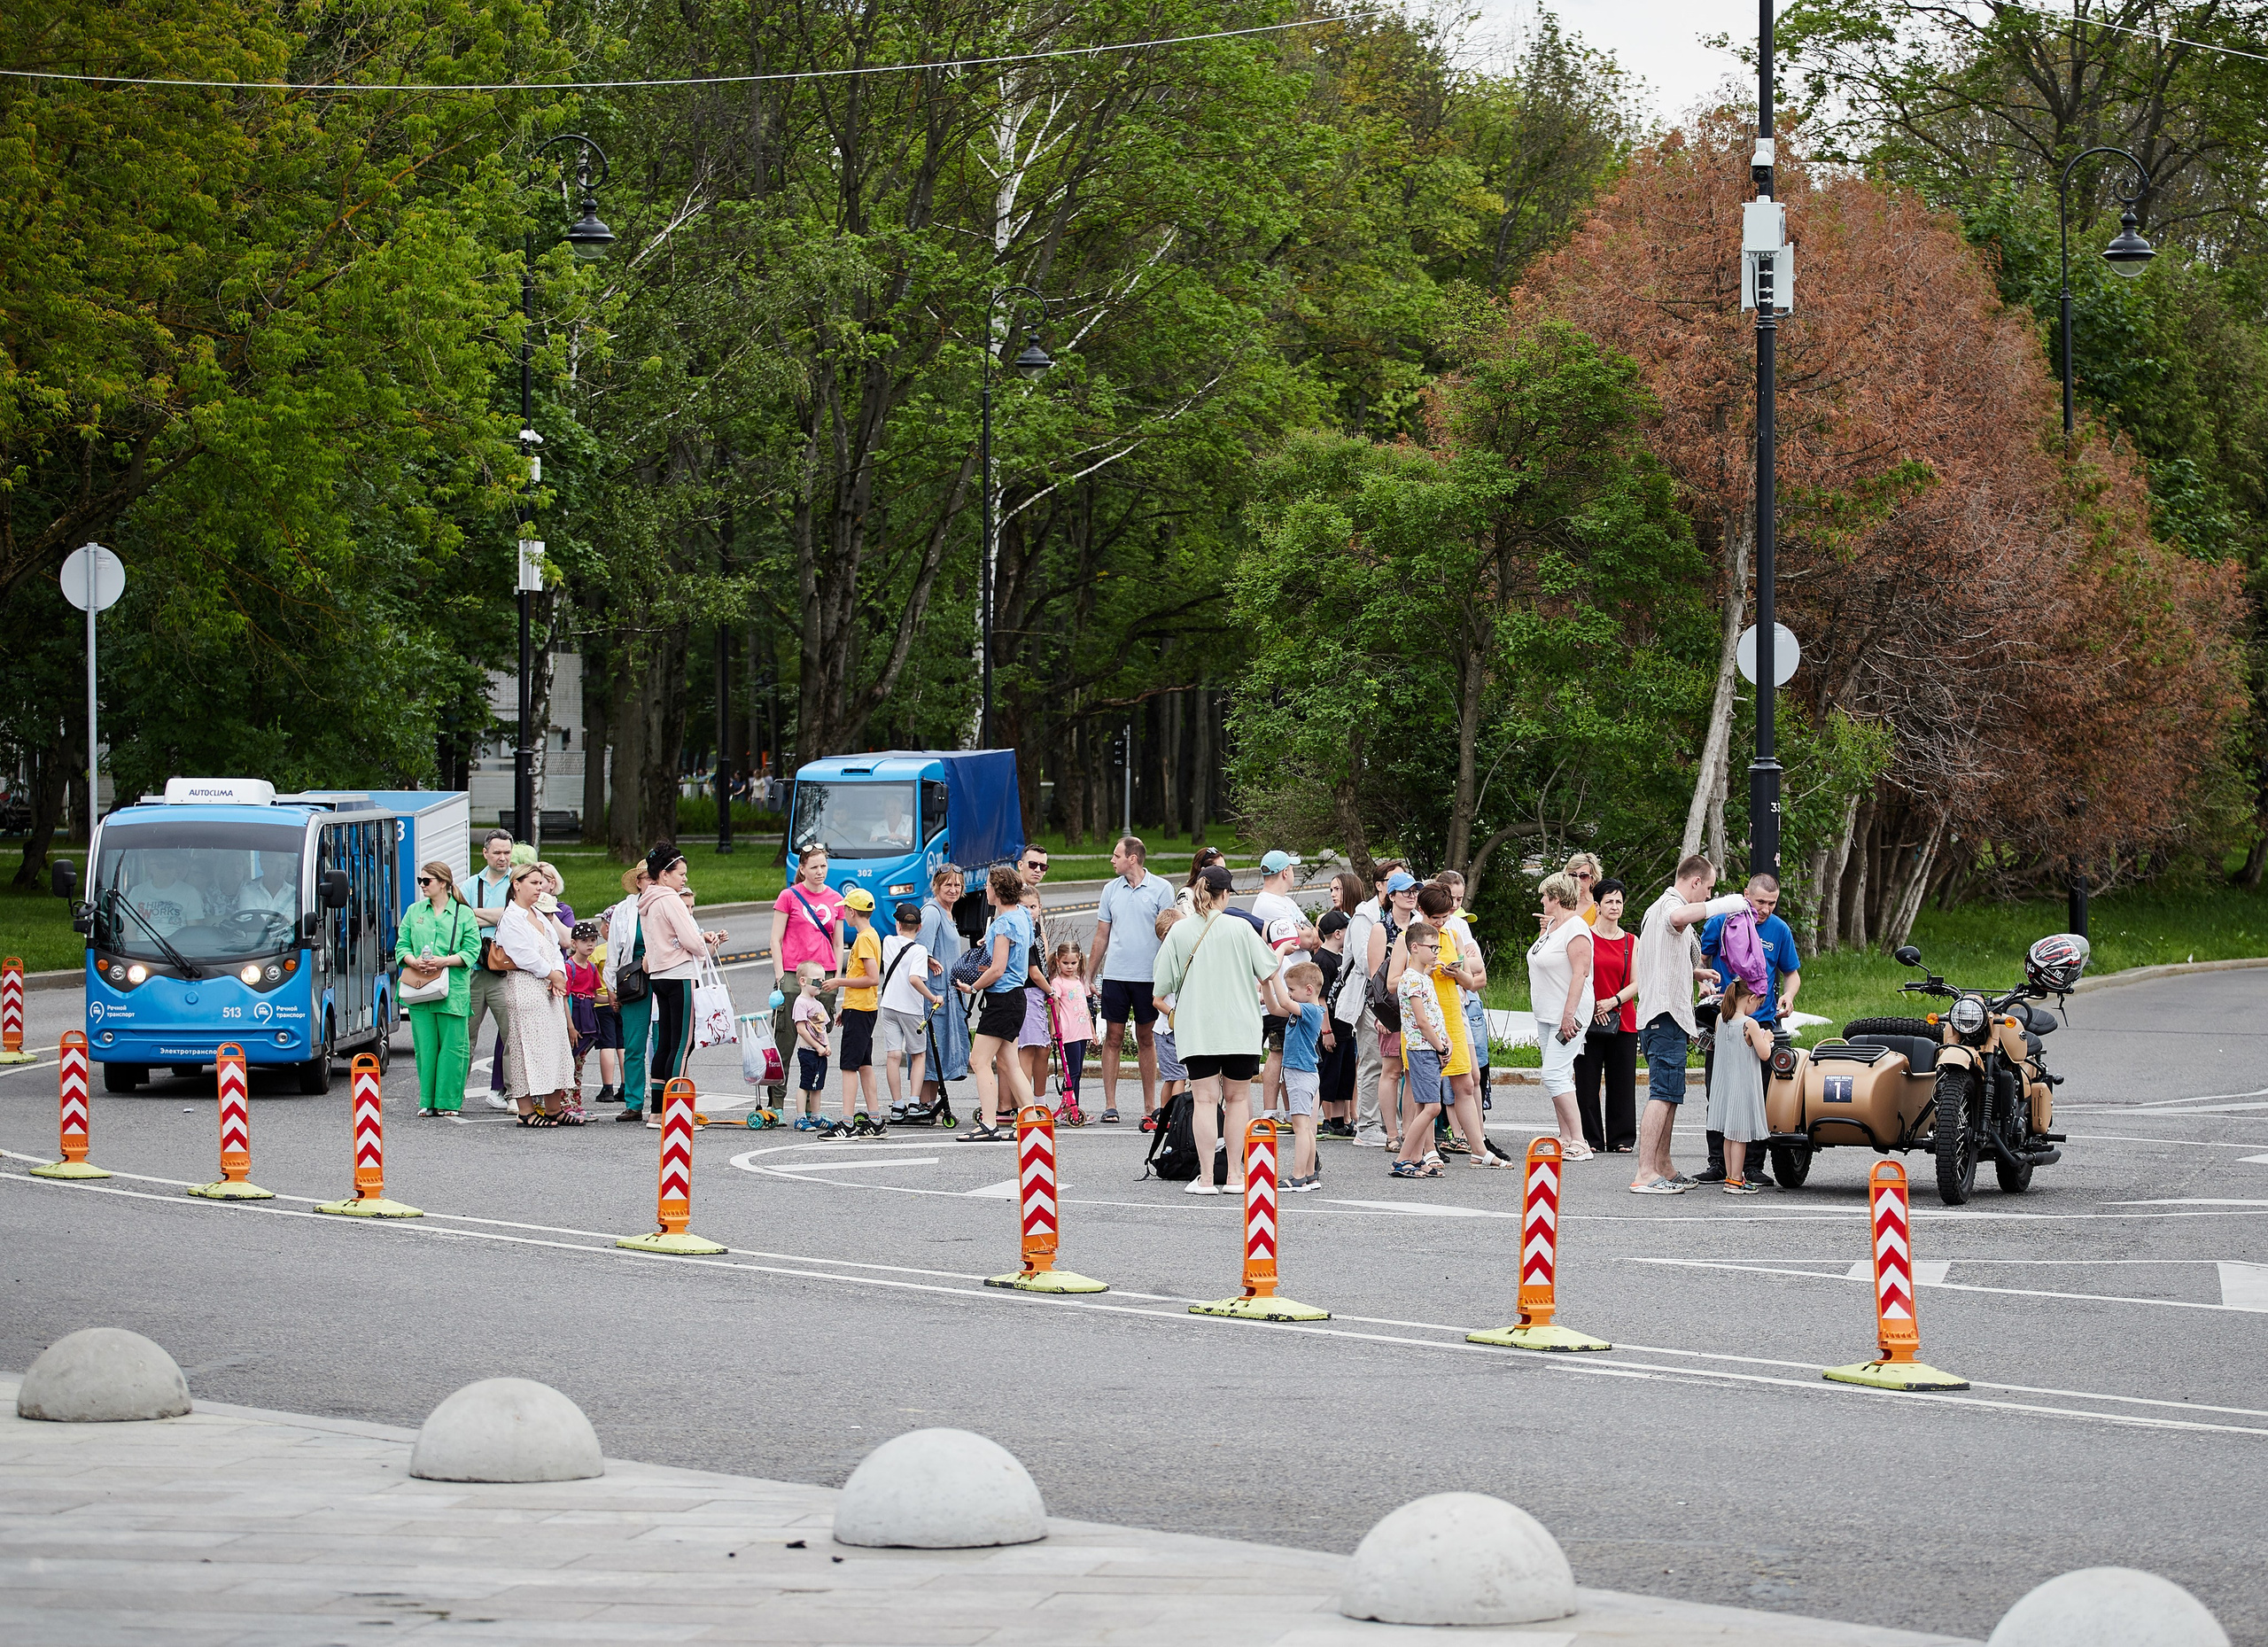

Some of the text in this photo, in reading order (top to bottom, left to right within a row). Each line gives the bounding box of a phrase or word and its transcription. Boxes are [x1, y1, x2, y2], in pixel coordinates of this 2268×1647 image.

[222, 1006, 242, 1018] 513
[159, 1047, 226, 1056] Электротранспот
[1834, 1081, 1841, 1099] 1
